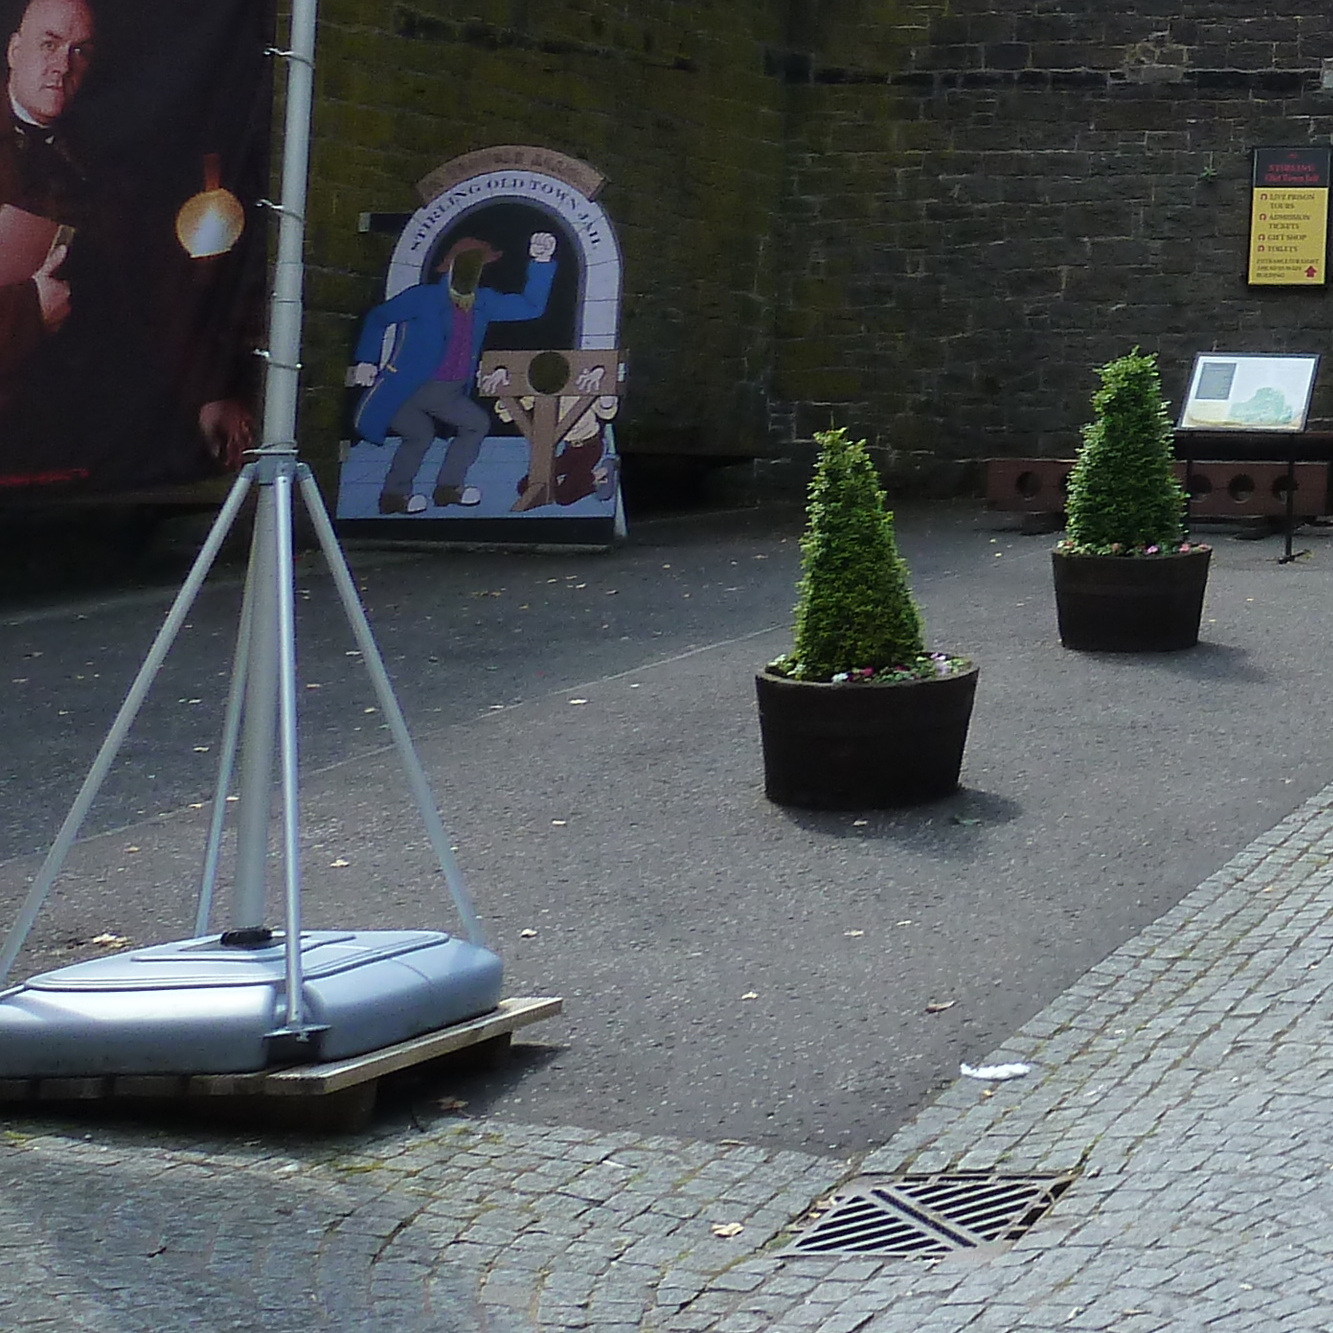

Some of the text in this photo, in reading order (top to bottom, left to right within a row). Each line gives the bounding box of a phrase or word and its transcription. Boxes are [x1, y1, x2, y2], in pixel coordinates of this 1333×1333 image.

[410, 183, 481, 251] STIRLING
[487, 178, 524, 189] OLD
[530, 179, 576, 210] TOWN
